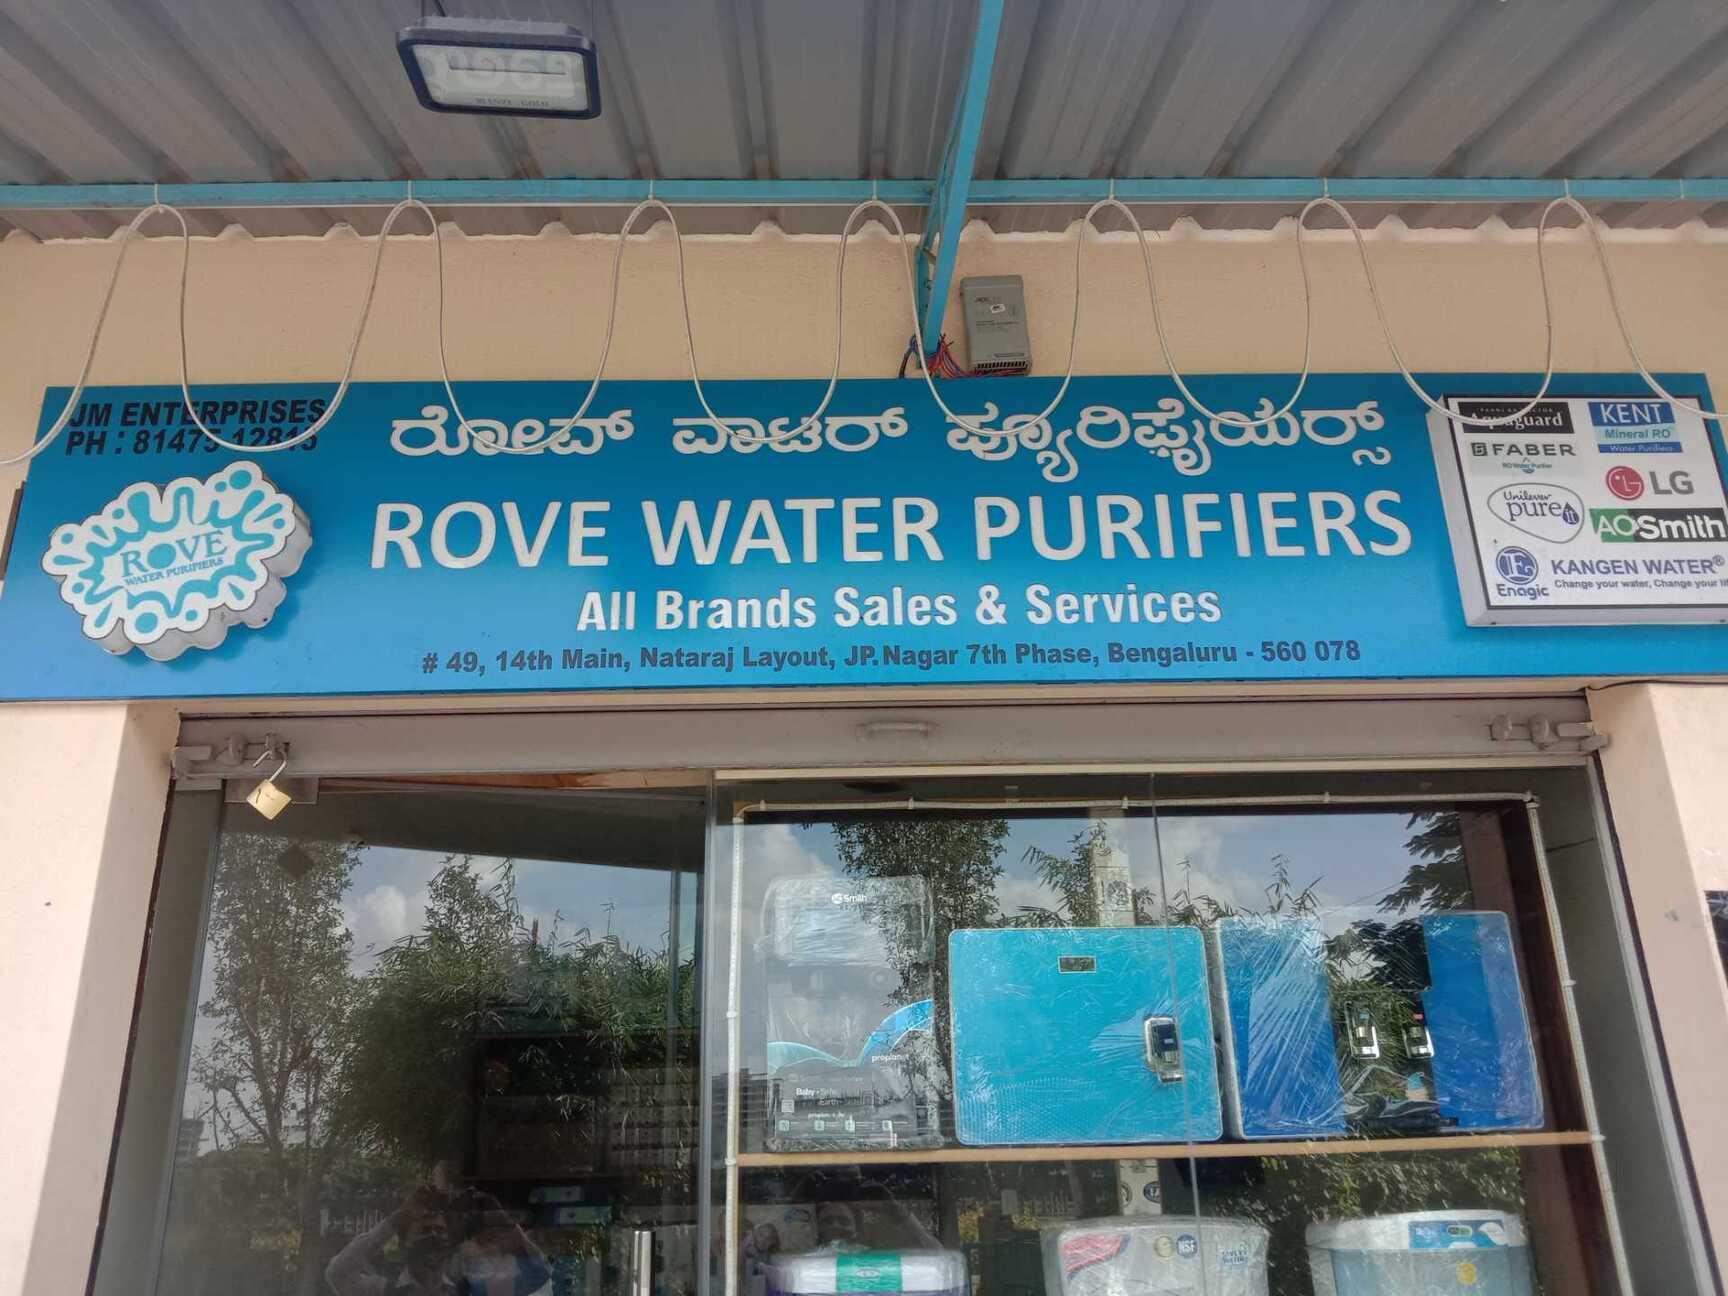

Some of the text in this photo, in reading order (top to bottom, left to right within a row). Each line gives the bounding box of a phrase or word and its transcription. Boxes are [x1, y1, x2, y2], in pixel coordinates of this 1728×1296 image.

[69, 398, 325, 427] JM ENTERPRISES
[1599, 403, 1662, 424] KENT
[66, 430, 106, 455] PH
[1604, 428, 1671, 440] Mineral RO
[1491, 443, 1577, 457] FABER
[1648, 470, 1695, 496] LG
[371, 491, 1414, 570] ROVE WATER PURIFIERS
[120, 530, 228, 578] ROVE
[125, 570, 164, 586] WATER
[1550, 559, 1639, 576] KANGEN
[1496, 584, 1550, 601] Enagic
[1554, 578, 1594, 591] Change
[1595, 580, 1619, 591] your
[1620, 579, 1653, 589] water,
[1653, 578, 1693, 589] Change
[1695, 579, 1718, 589] your
[576, 583, 1223, 632] All Brands Sales & Services
[422, 653, 438, 674] #
[446, 652, 486, 675] 49,
[496, 650, 553, 672] 14th
[561, 648, 630, 672] Main,
[640, 647, 734, 673] Nataraj
[743, 646, 836, 672] Layout,
[966, 644, 1008, 665] 7th
[1015, 643, 1100, 668] Phase,
[1108, 642, 1237, 668] Bengaluru
[1261, 641, 1306, 662] 560
[1314, 640, 1362, 661] 078
